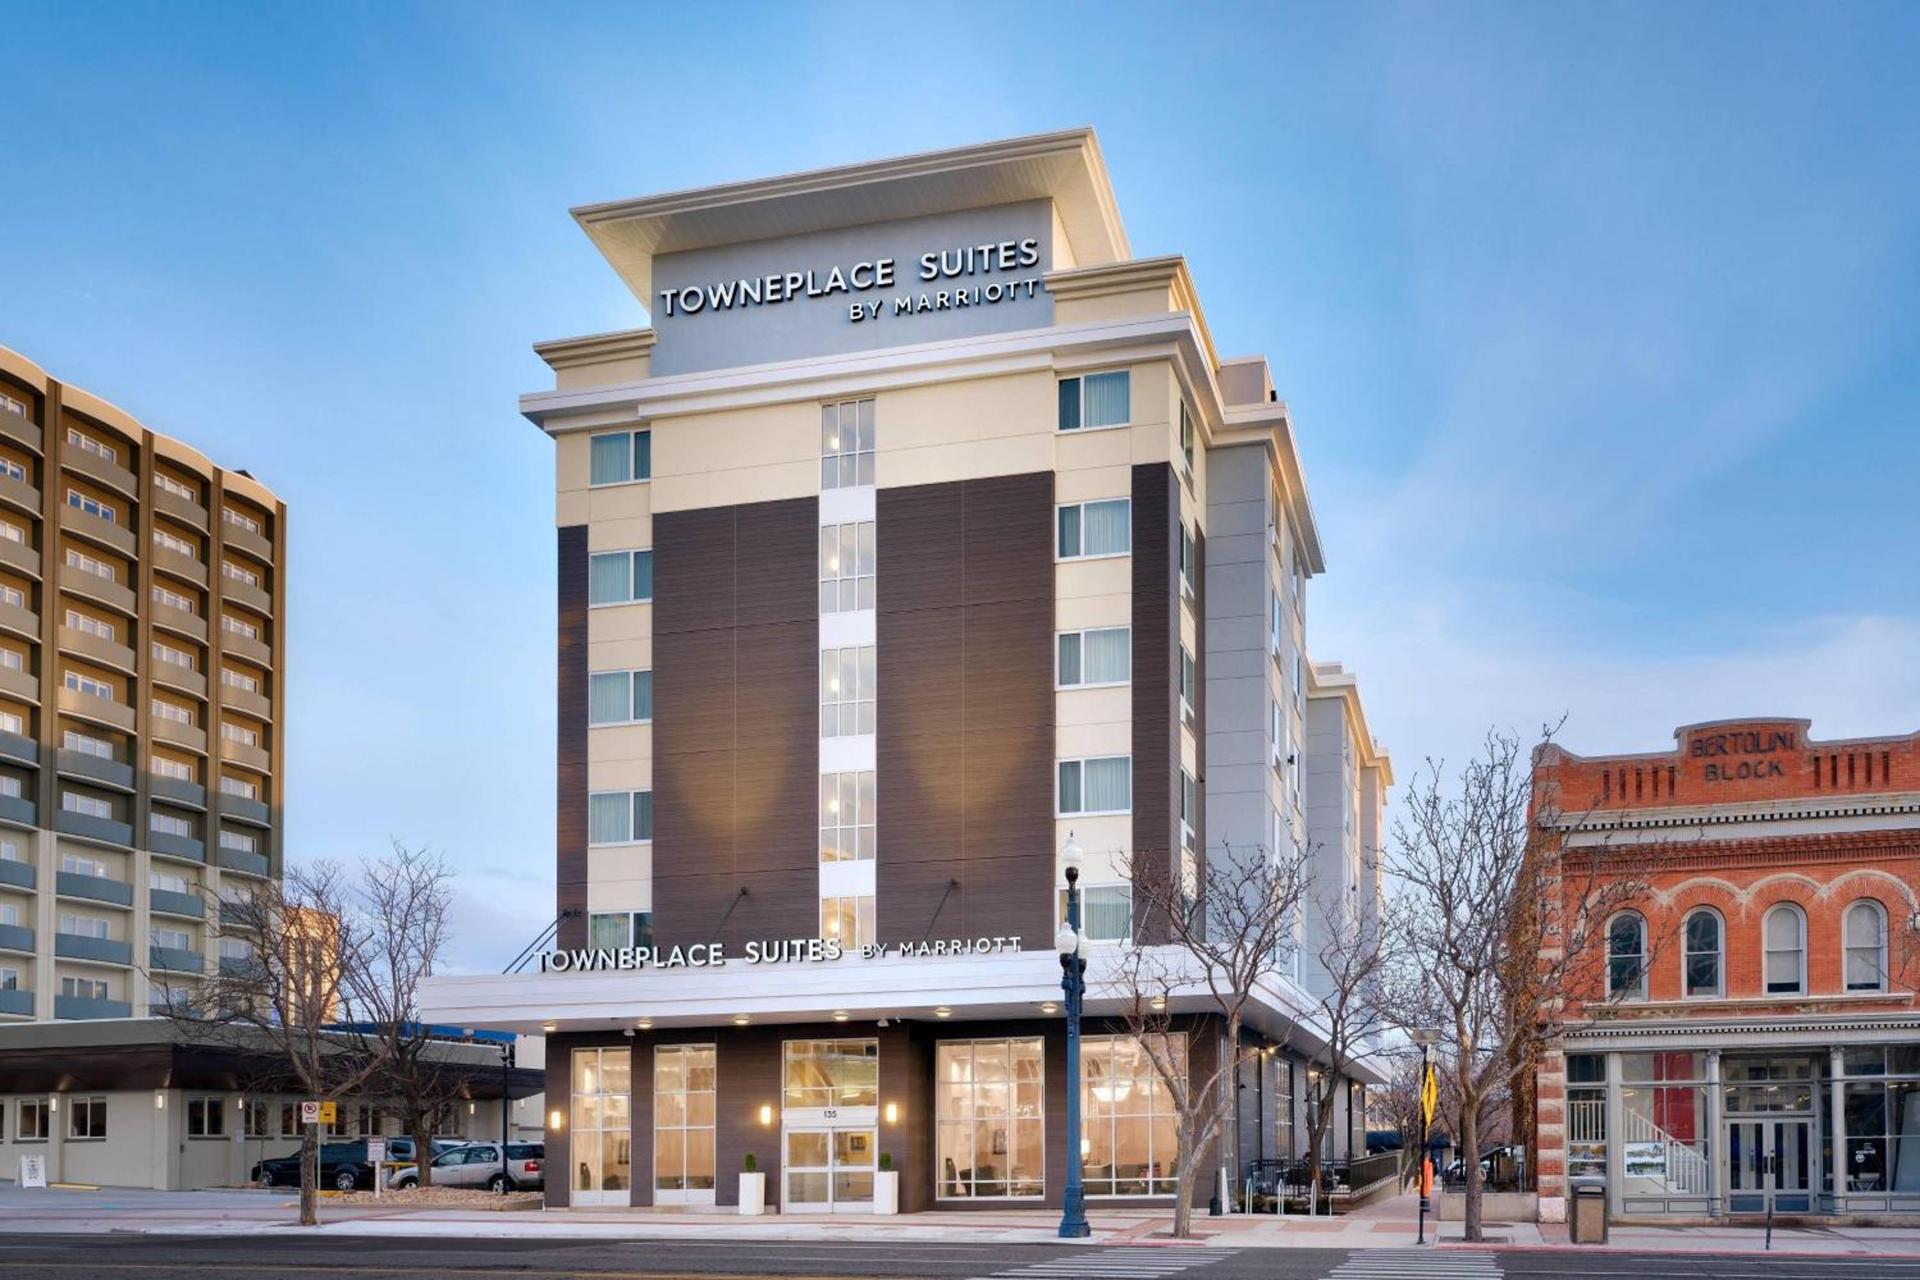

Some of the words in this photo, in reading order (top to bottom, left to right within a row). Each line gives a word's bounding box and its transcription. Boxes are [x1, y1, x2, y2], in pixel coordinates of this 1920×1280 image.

[661, 259, 895, 316] TOWNEPLACE
[919, 238, 1040, 281] SUITES
[849, 300, 881, 322] BY
[894, 279, 1039, 314] MARRIOTT
[1706, 762, 1783, 781] BLOCK
[535, 943, 726, 972] TOWNEPLACE
[744, 938, 842, 963] SUITES
[861, 943, 888, 959] BY
[900, 936, 1021, 956] MARRIOTT
